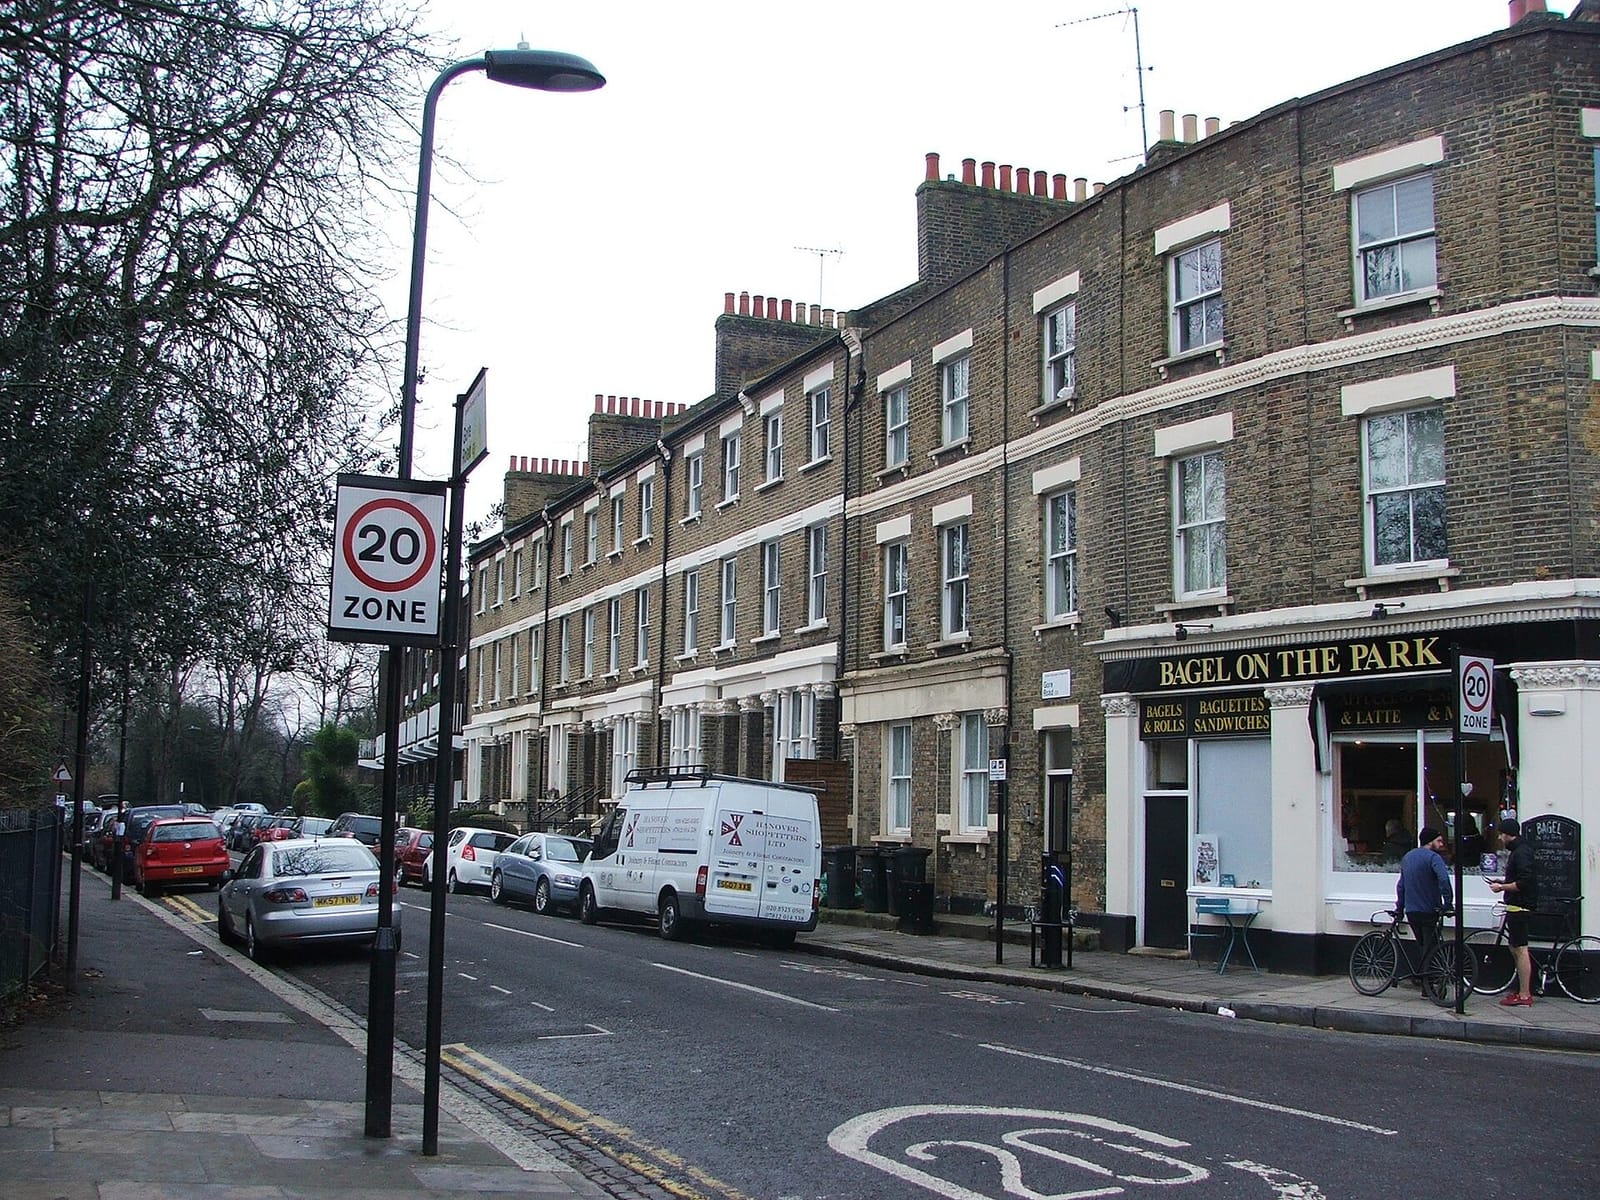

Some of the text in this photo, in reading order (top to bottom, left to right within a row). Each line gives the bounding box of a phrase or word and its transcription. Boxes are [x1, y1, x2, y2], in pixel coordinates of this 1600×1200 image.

[359, 524, 420, 565] 20
[343, 595, 426, 623] ZONE
[1159, 637, 1442, 686] BAGEL ON THE PARK
[1466, 676, 1486, 698] 20
[1146, 703, 1183, 718] BAGELS
[1199, 697, 1265, 715] BAGUETTES
[1427, 705, 1441, 721] &
[1194, 714, 1270, 732] SANDWICHES
[1340, 709, 1401, 725] & LATTE
[1463, 714, 1488, 729] ZONE
[1143, 719, 1185, 733] & ROLLS
[1536, 821, 1561, 835] BAGEL
[767, 840, 786, 848] LTD
[905, 1128, 1211, 1200] 20
